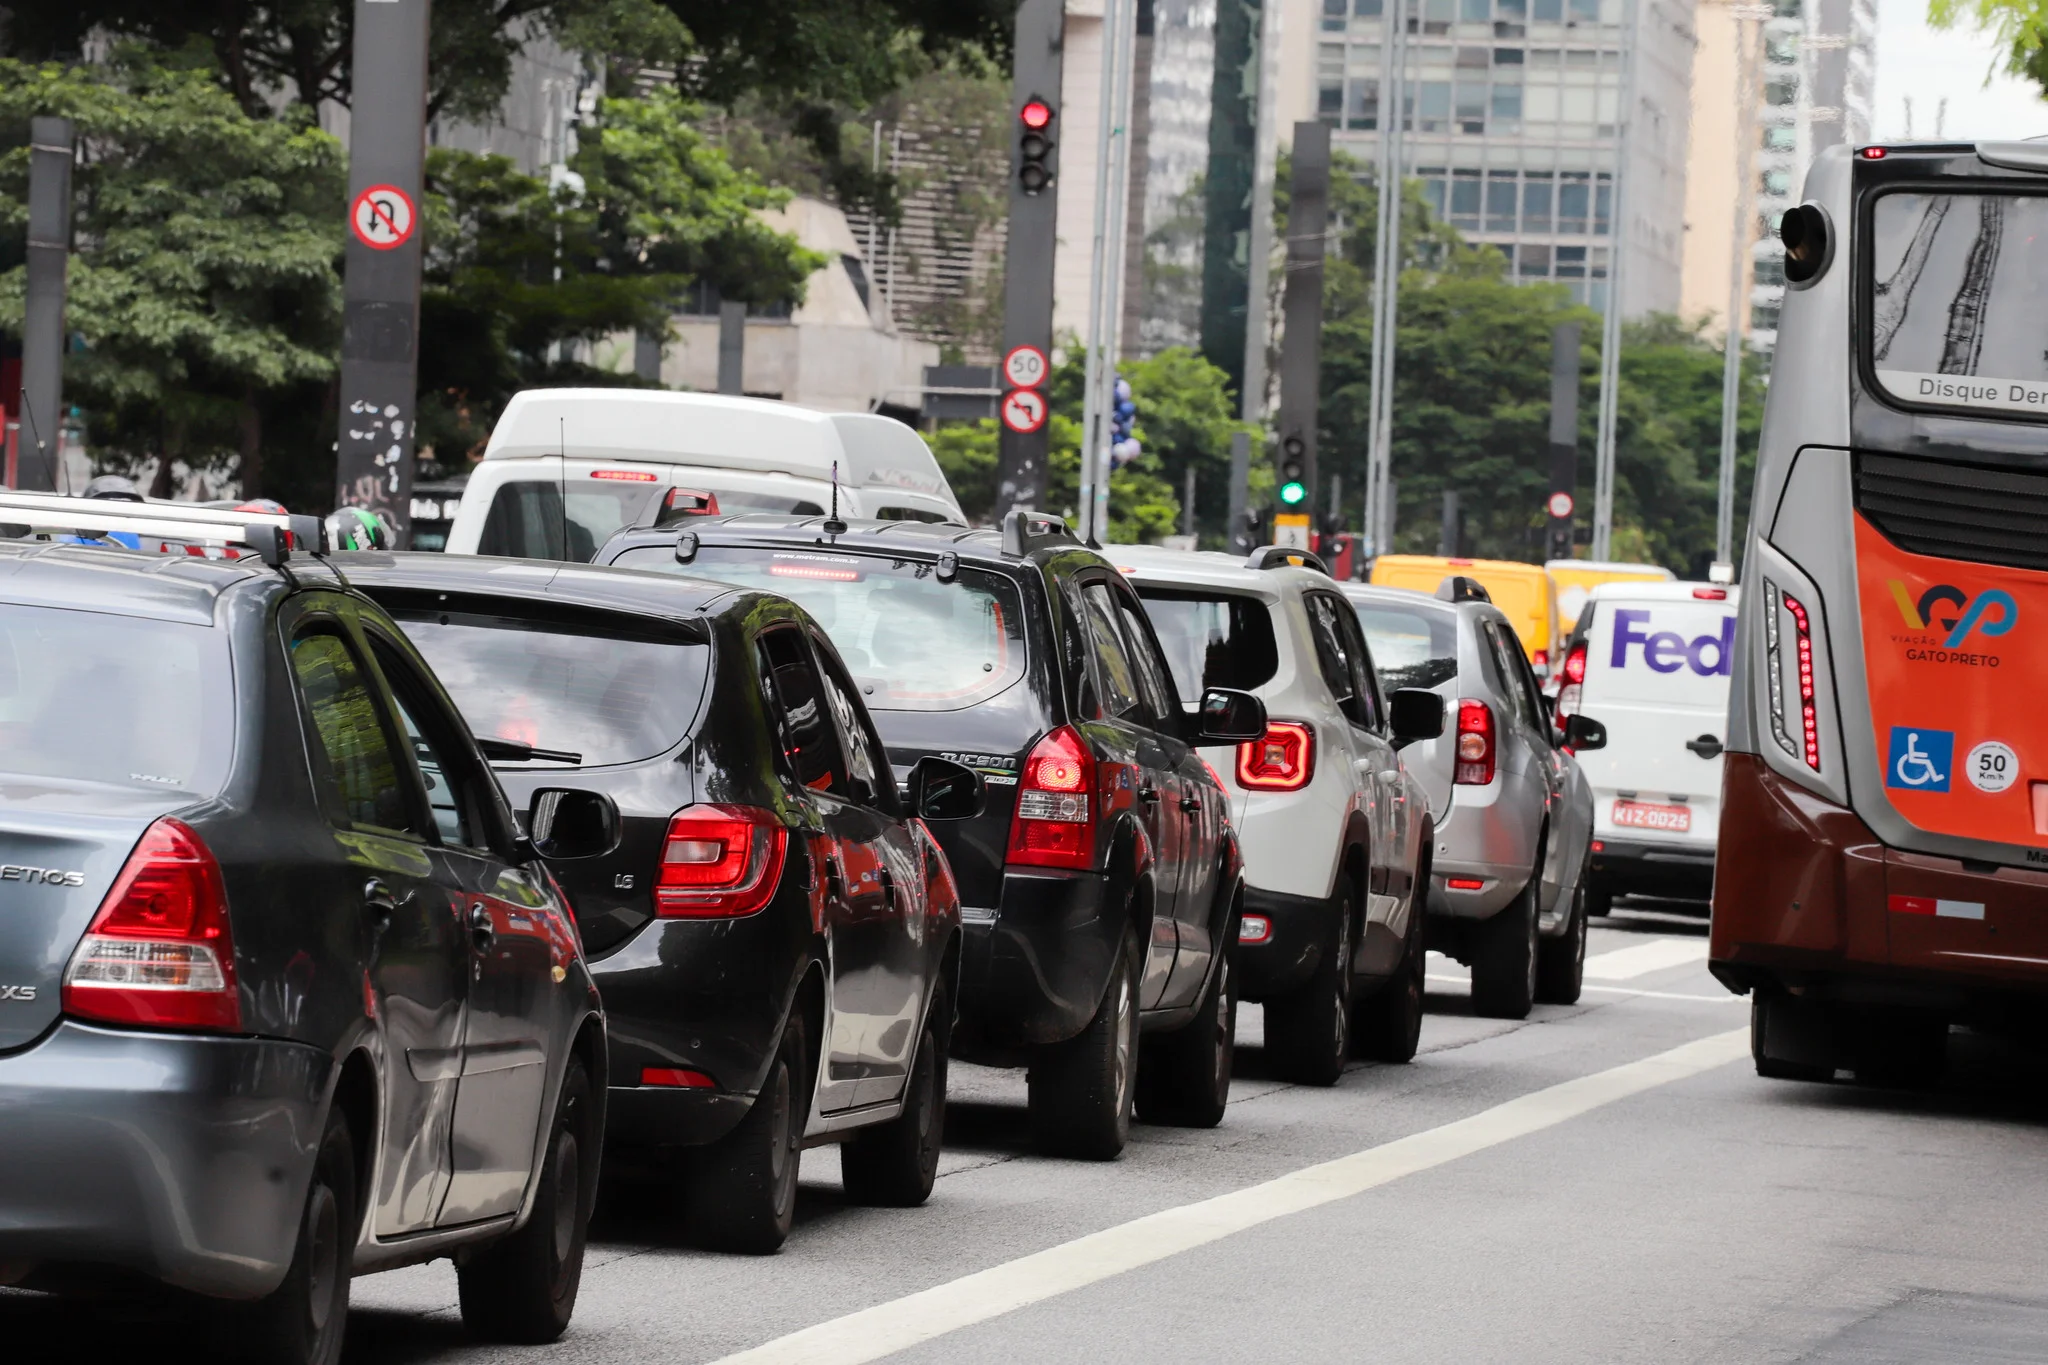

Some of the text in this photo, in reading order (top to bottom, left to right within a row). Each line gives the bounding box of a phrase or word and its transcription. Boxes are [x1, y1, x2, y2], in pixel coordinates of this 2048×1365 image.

[1013, 356, 1040, 373] 50
[1919, 378, 1998, 402] Disque
[1610, 608, 1738, 676] Fed
[1906, 648, 2000, 667] GATO PRETO
[1979, 753, 2006, 772] 50
[0, 864, 85, 887] ETIOS
